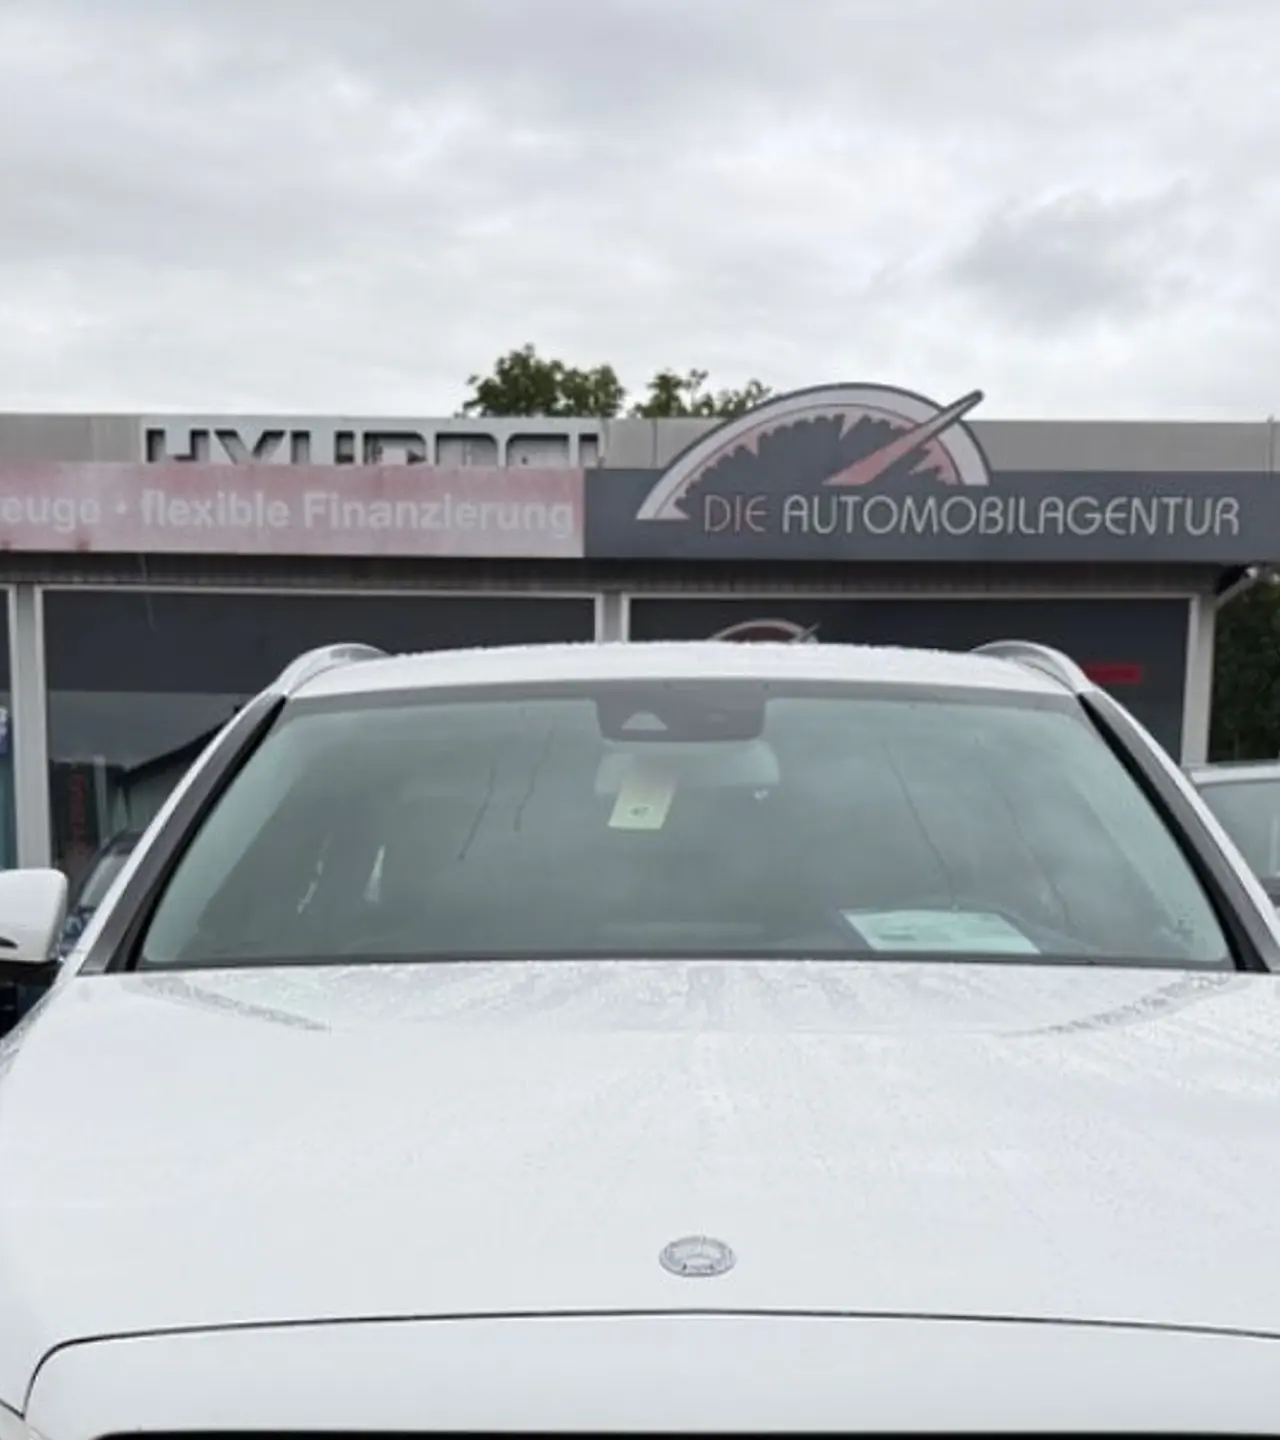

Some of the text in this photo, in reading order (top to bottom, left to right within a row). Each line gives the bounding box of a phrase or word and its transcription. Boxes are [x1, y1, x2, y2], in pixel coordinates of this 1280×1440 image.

[139, 489, 290, 528] flexible
[302, 490, 575, 538] Finanzierung
[703, 494, 1240, 537] DIE AUTOMOBILAGENTUR
